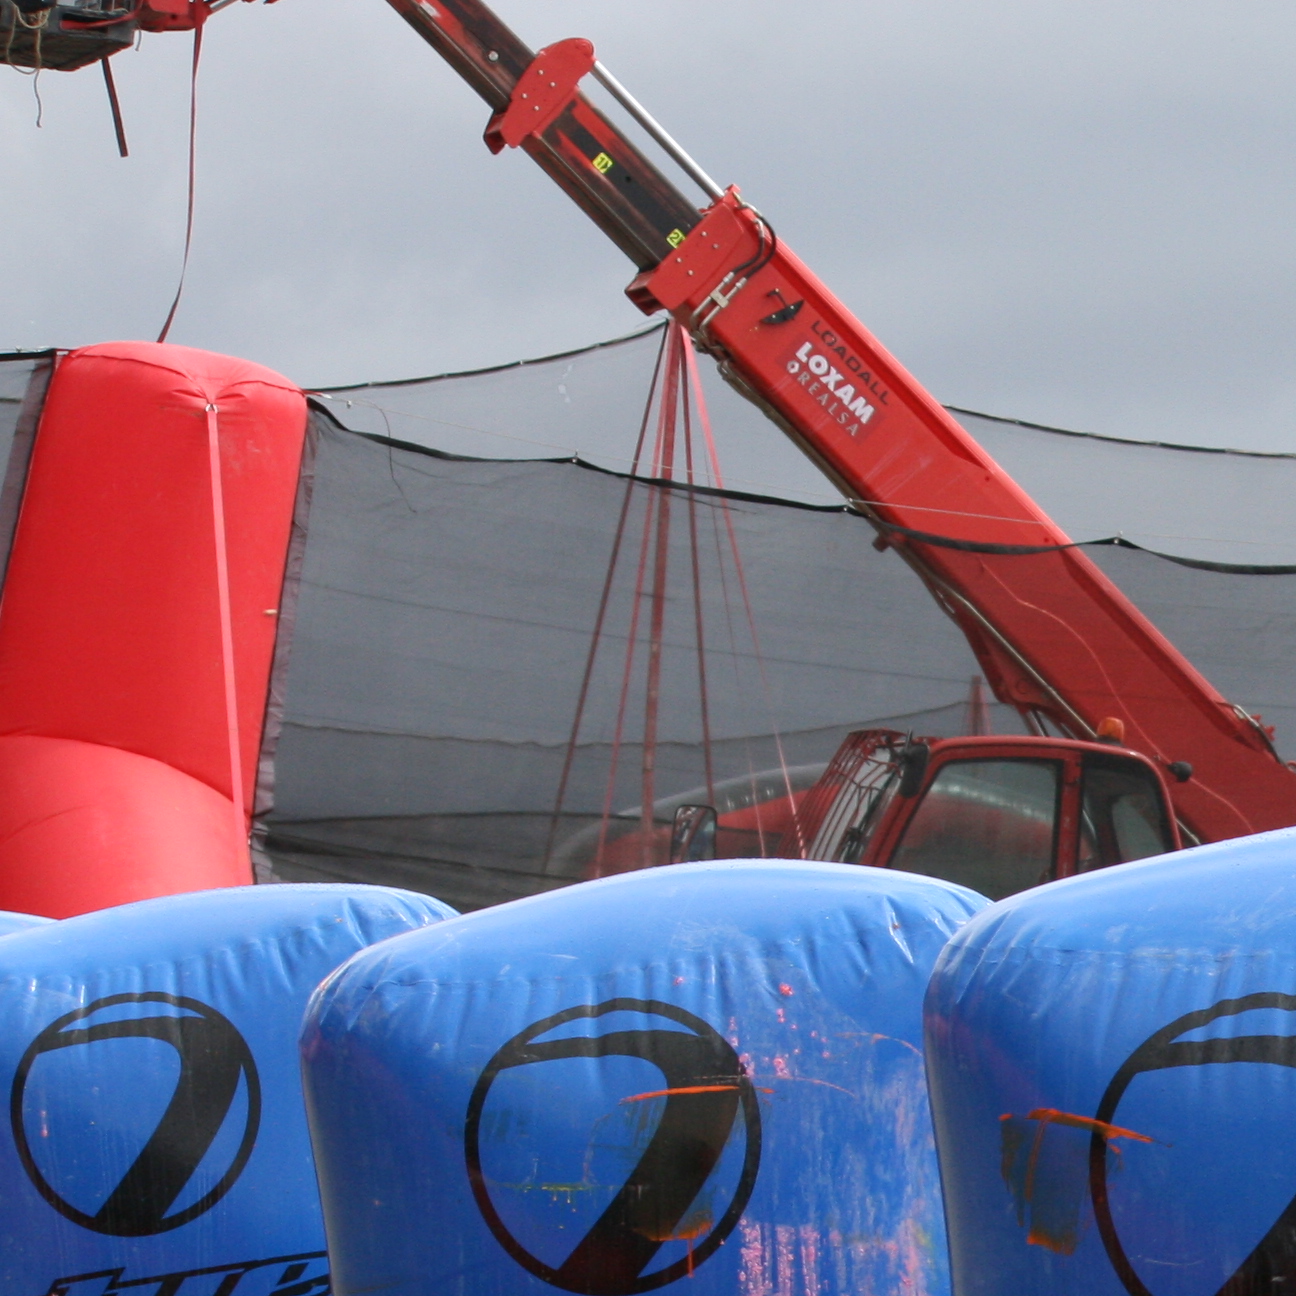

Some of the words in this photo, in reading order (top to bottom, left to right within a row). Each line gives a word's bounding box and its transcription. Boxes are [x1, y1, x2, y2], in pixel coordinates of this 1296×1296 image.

[795, 341, 875, 424] LOXAM
[797, 371, 859, 437] REALSA
[810, 320, 889, 406] LOADALL
